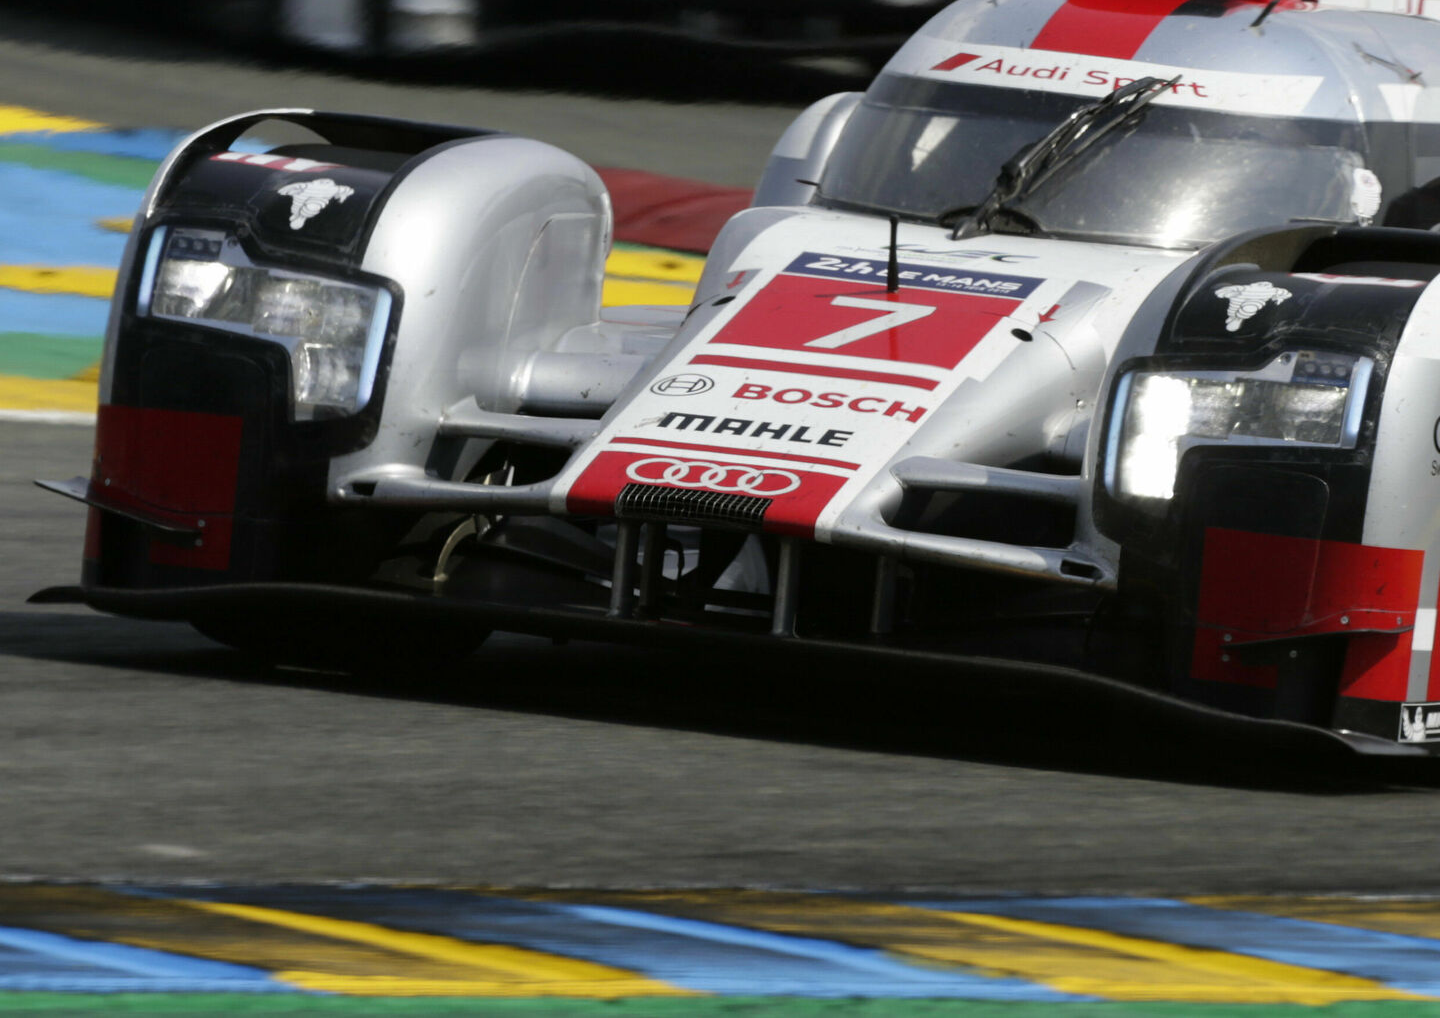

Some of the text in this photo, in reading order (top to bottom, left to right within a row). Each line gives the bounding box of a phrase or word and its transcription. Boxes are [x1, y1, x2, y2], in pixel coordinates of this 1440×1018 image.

[975, 58, 1070, 81] Audi
[921, 273, 1023, 291] MANS
[802, 295, 937, 349] 7
[732, 382, 928, 423] BOSCH
[657, 411, 854, 448] MAHLE
